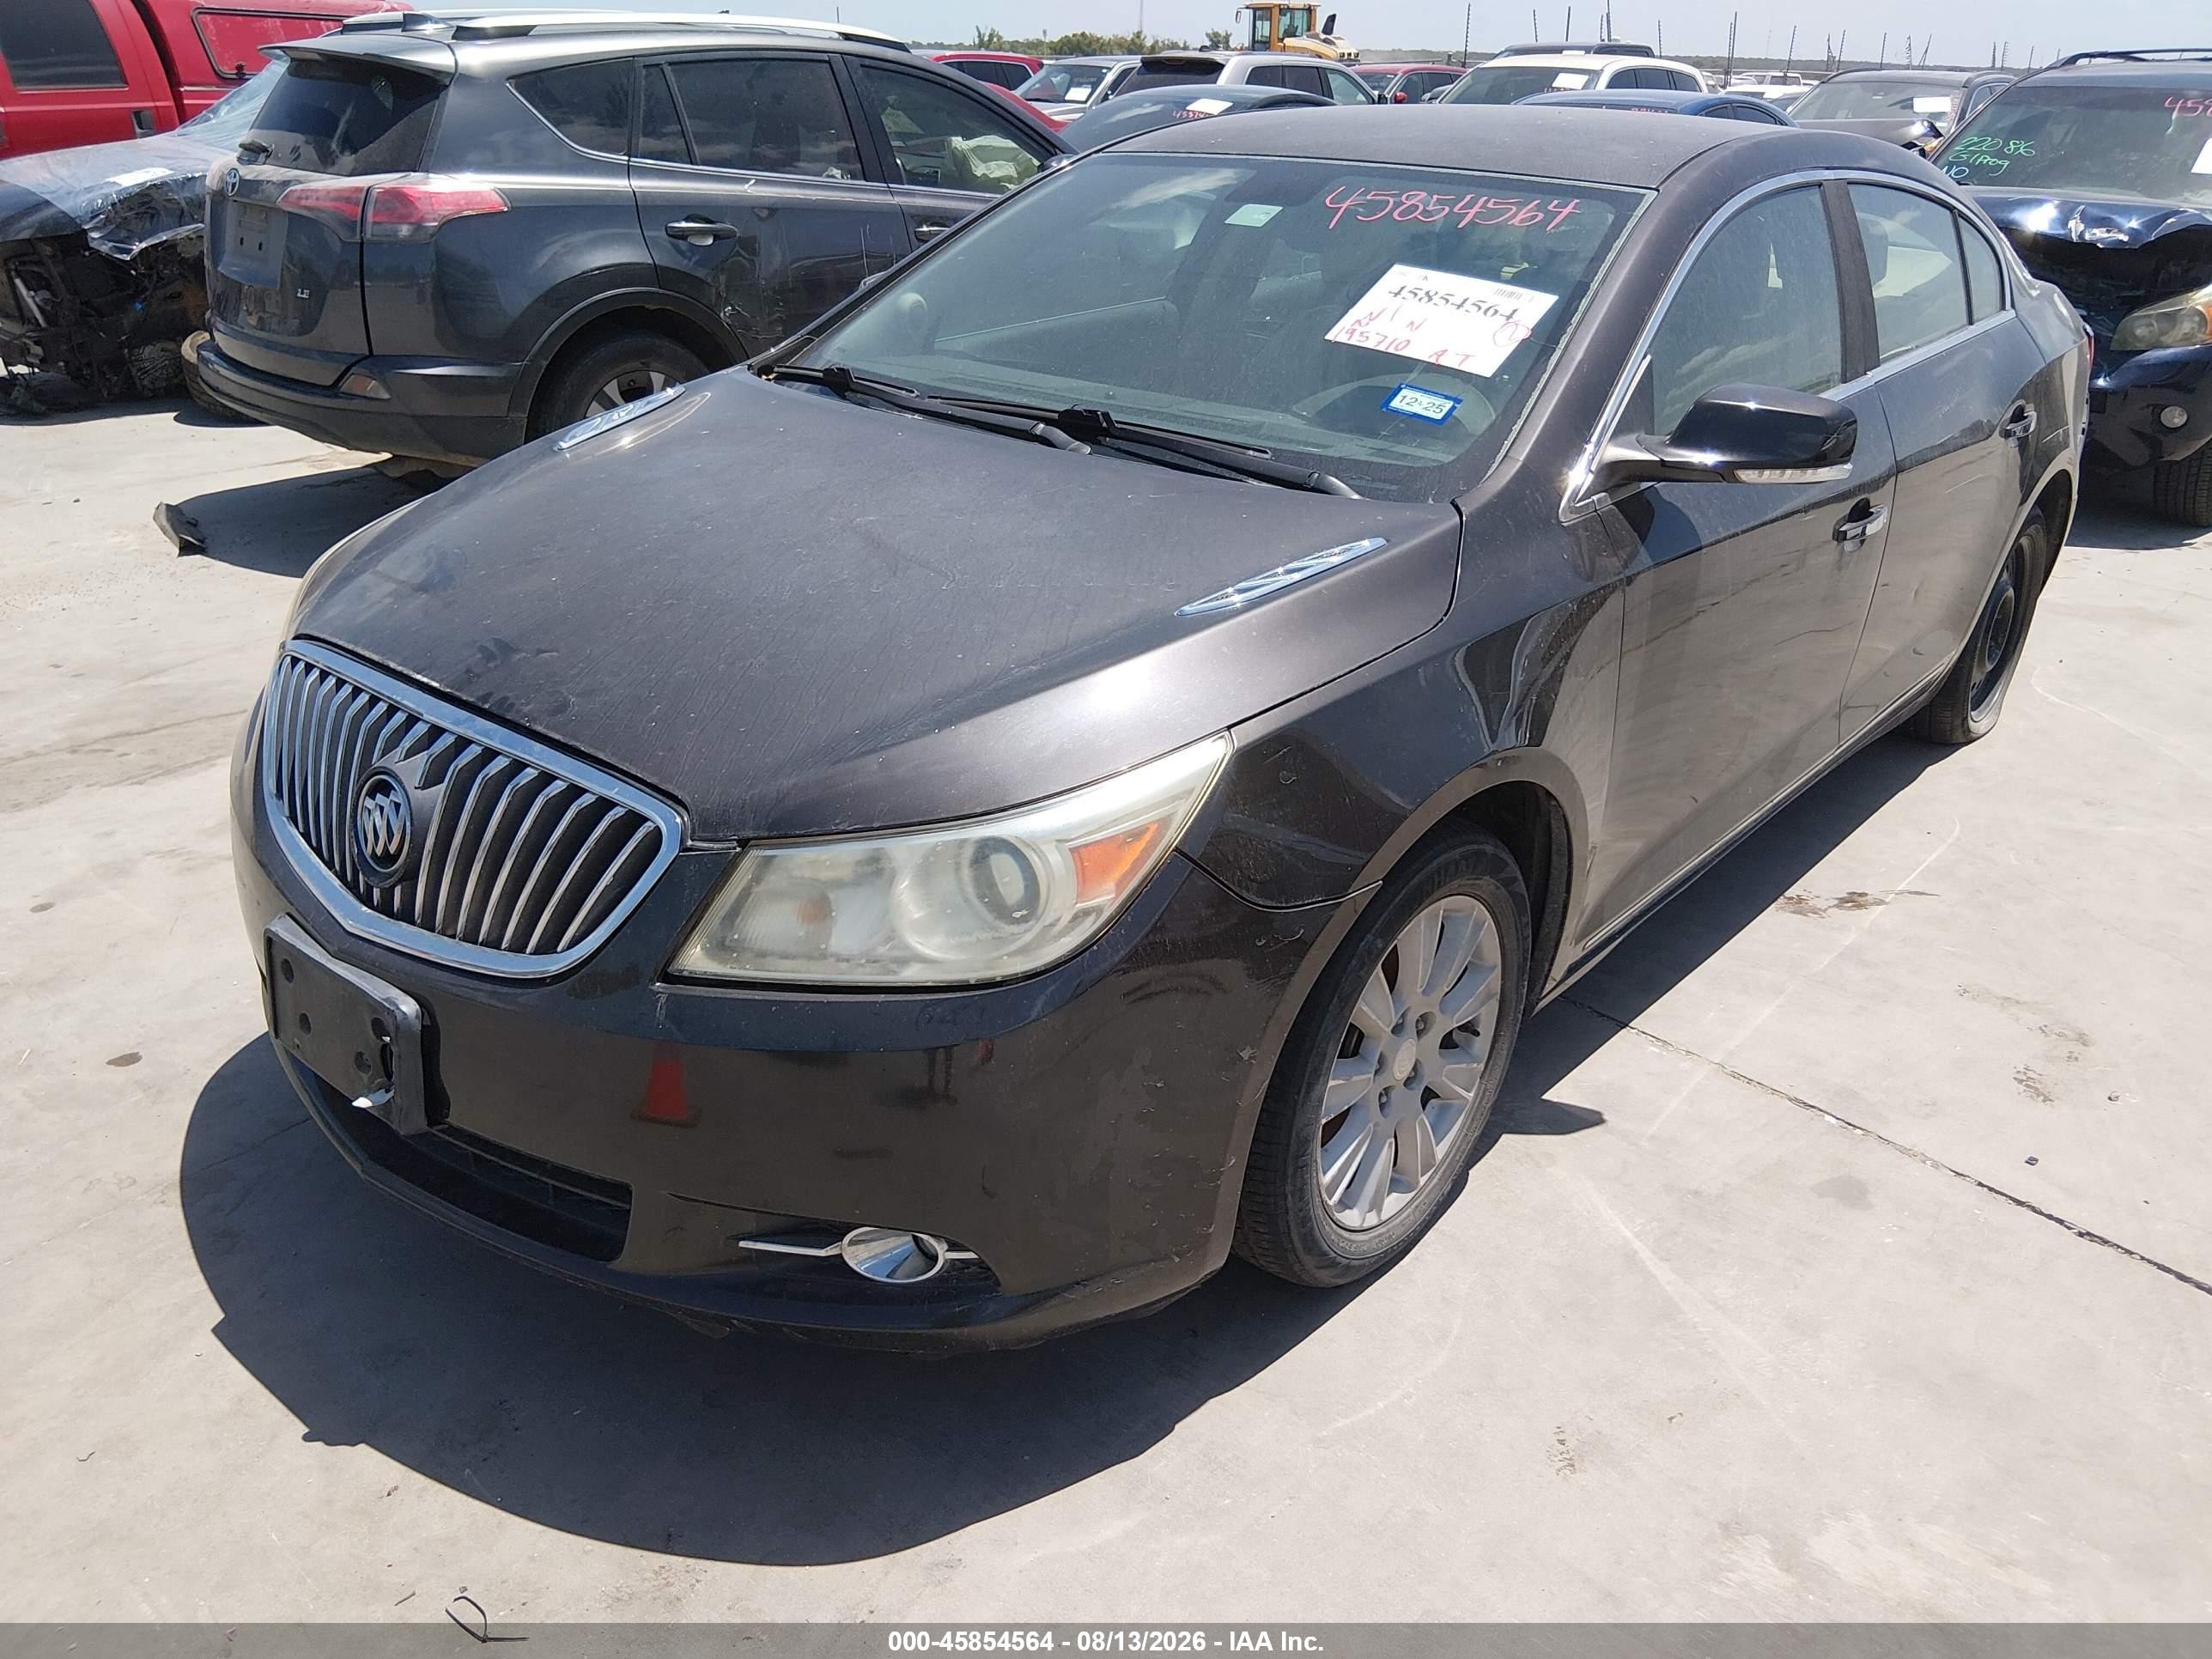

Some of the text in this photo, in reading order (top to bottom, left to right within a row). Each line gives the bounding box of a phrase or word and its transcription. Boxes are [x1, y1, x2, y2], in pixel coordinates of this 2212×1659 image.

[1325, 185, 1581, 232] 45854564
[296, 288, 310, 299] LE
[1388, 285, 1520, 321] 45854564
